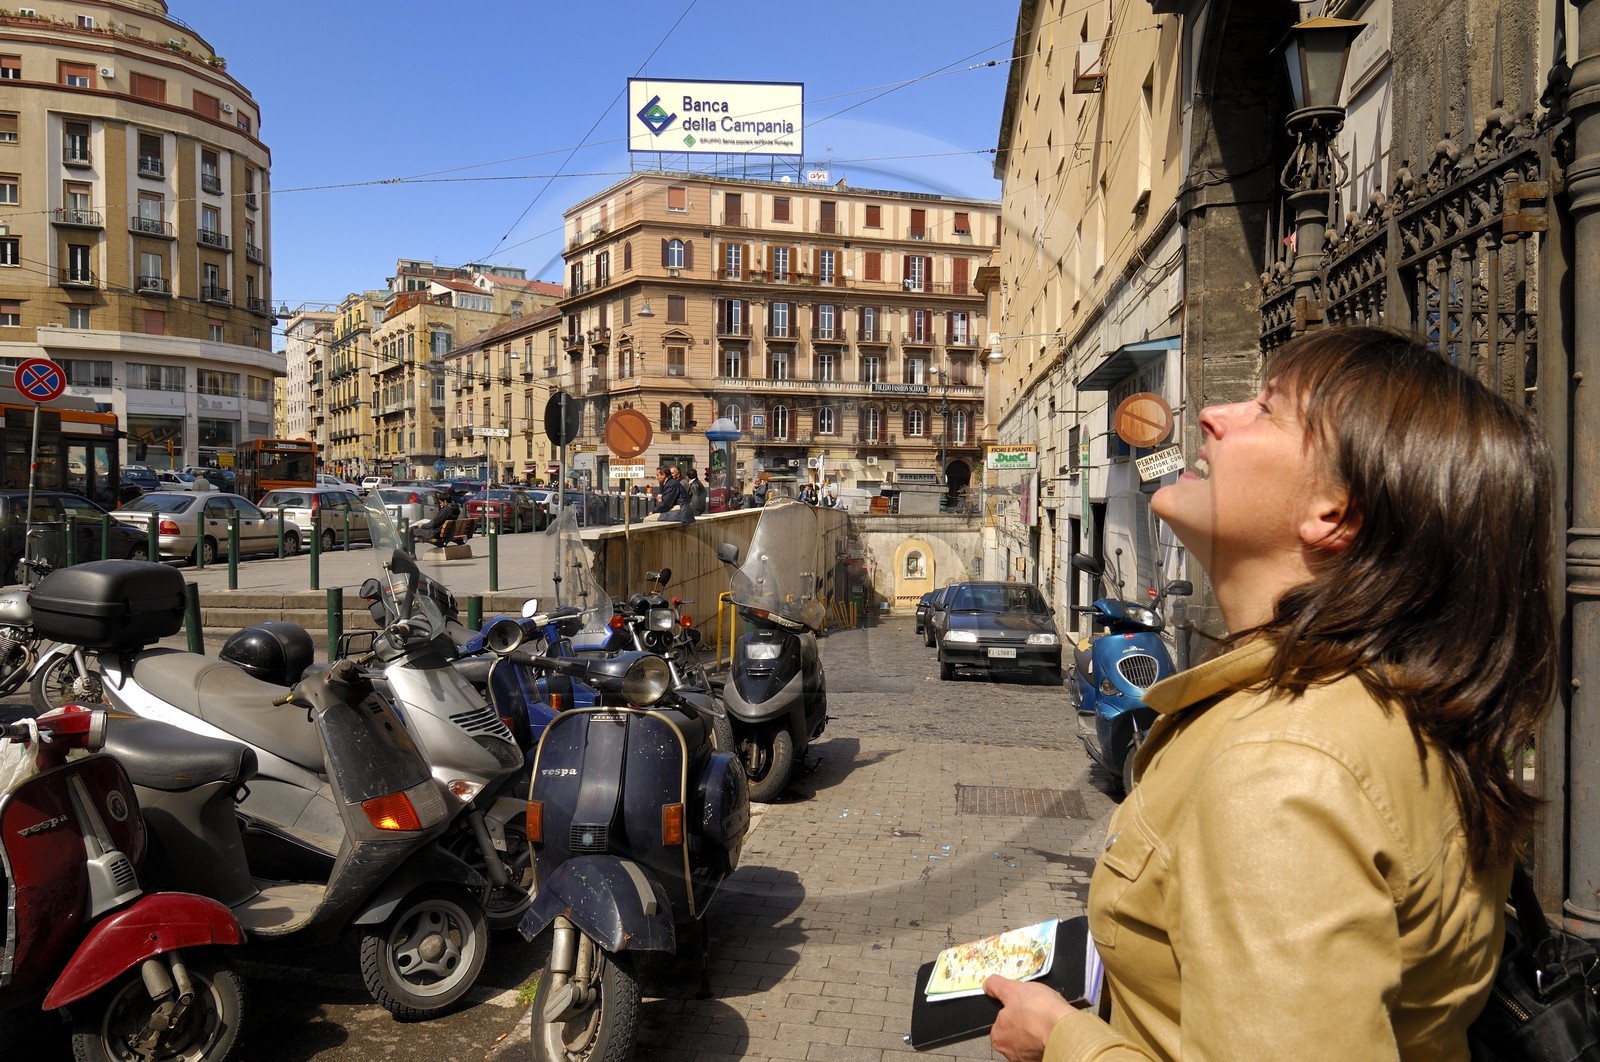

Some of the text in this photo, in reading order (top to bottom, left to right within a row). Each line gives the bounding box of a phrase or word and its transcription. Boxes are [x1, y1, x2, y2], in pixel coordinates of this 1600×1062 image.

[682, 95, 729, 112] Banca
[682, 116, 794, 136] della Campania
[1136, 446, 1180, 468] PERMANENTE
[1140, 454, 1182, 474] RIMOZIONE CON
[1148, 463, 1178, 478] CARRI GRU
[541, 768, 578, 777] vespa
[17, 814, 68, 836] vespa
